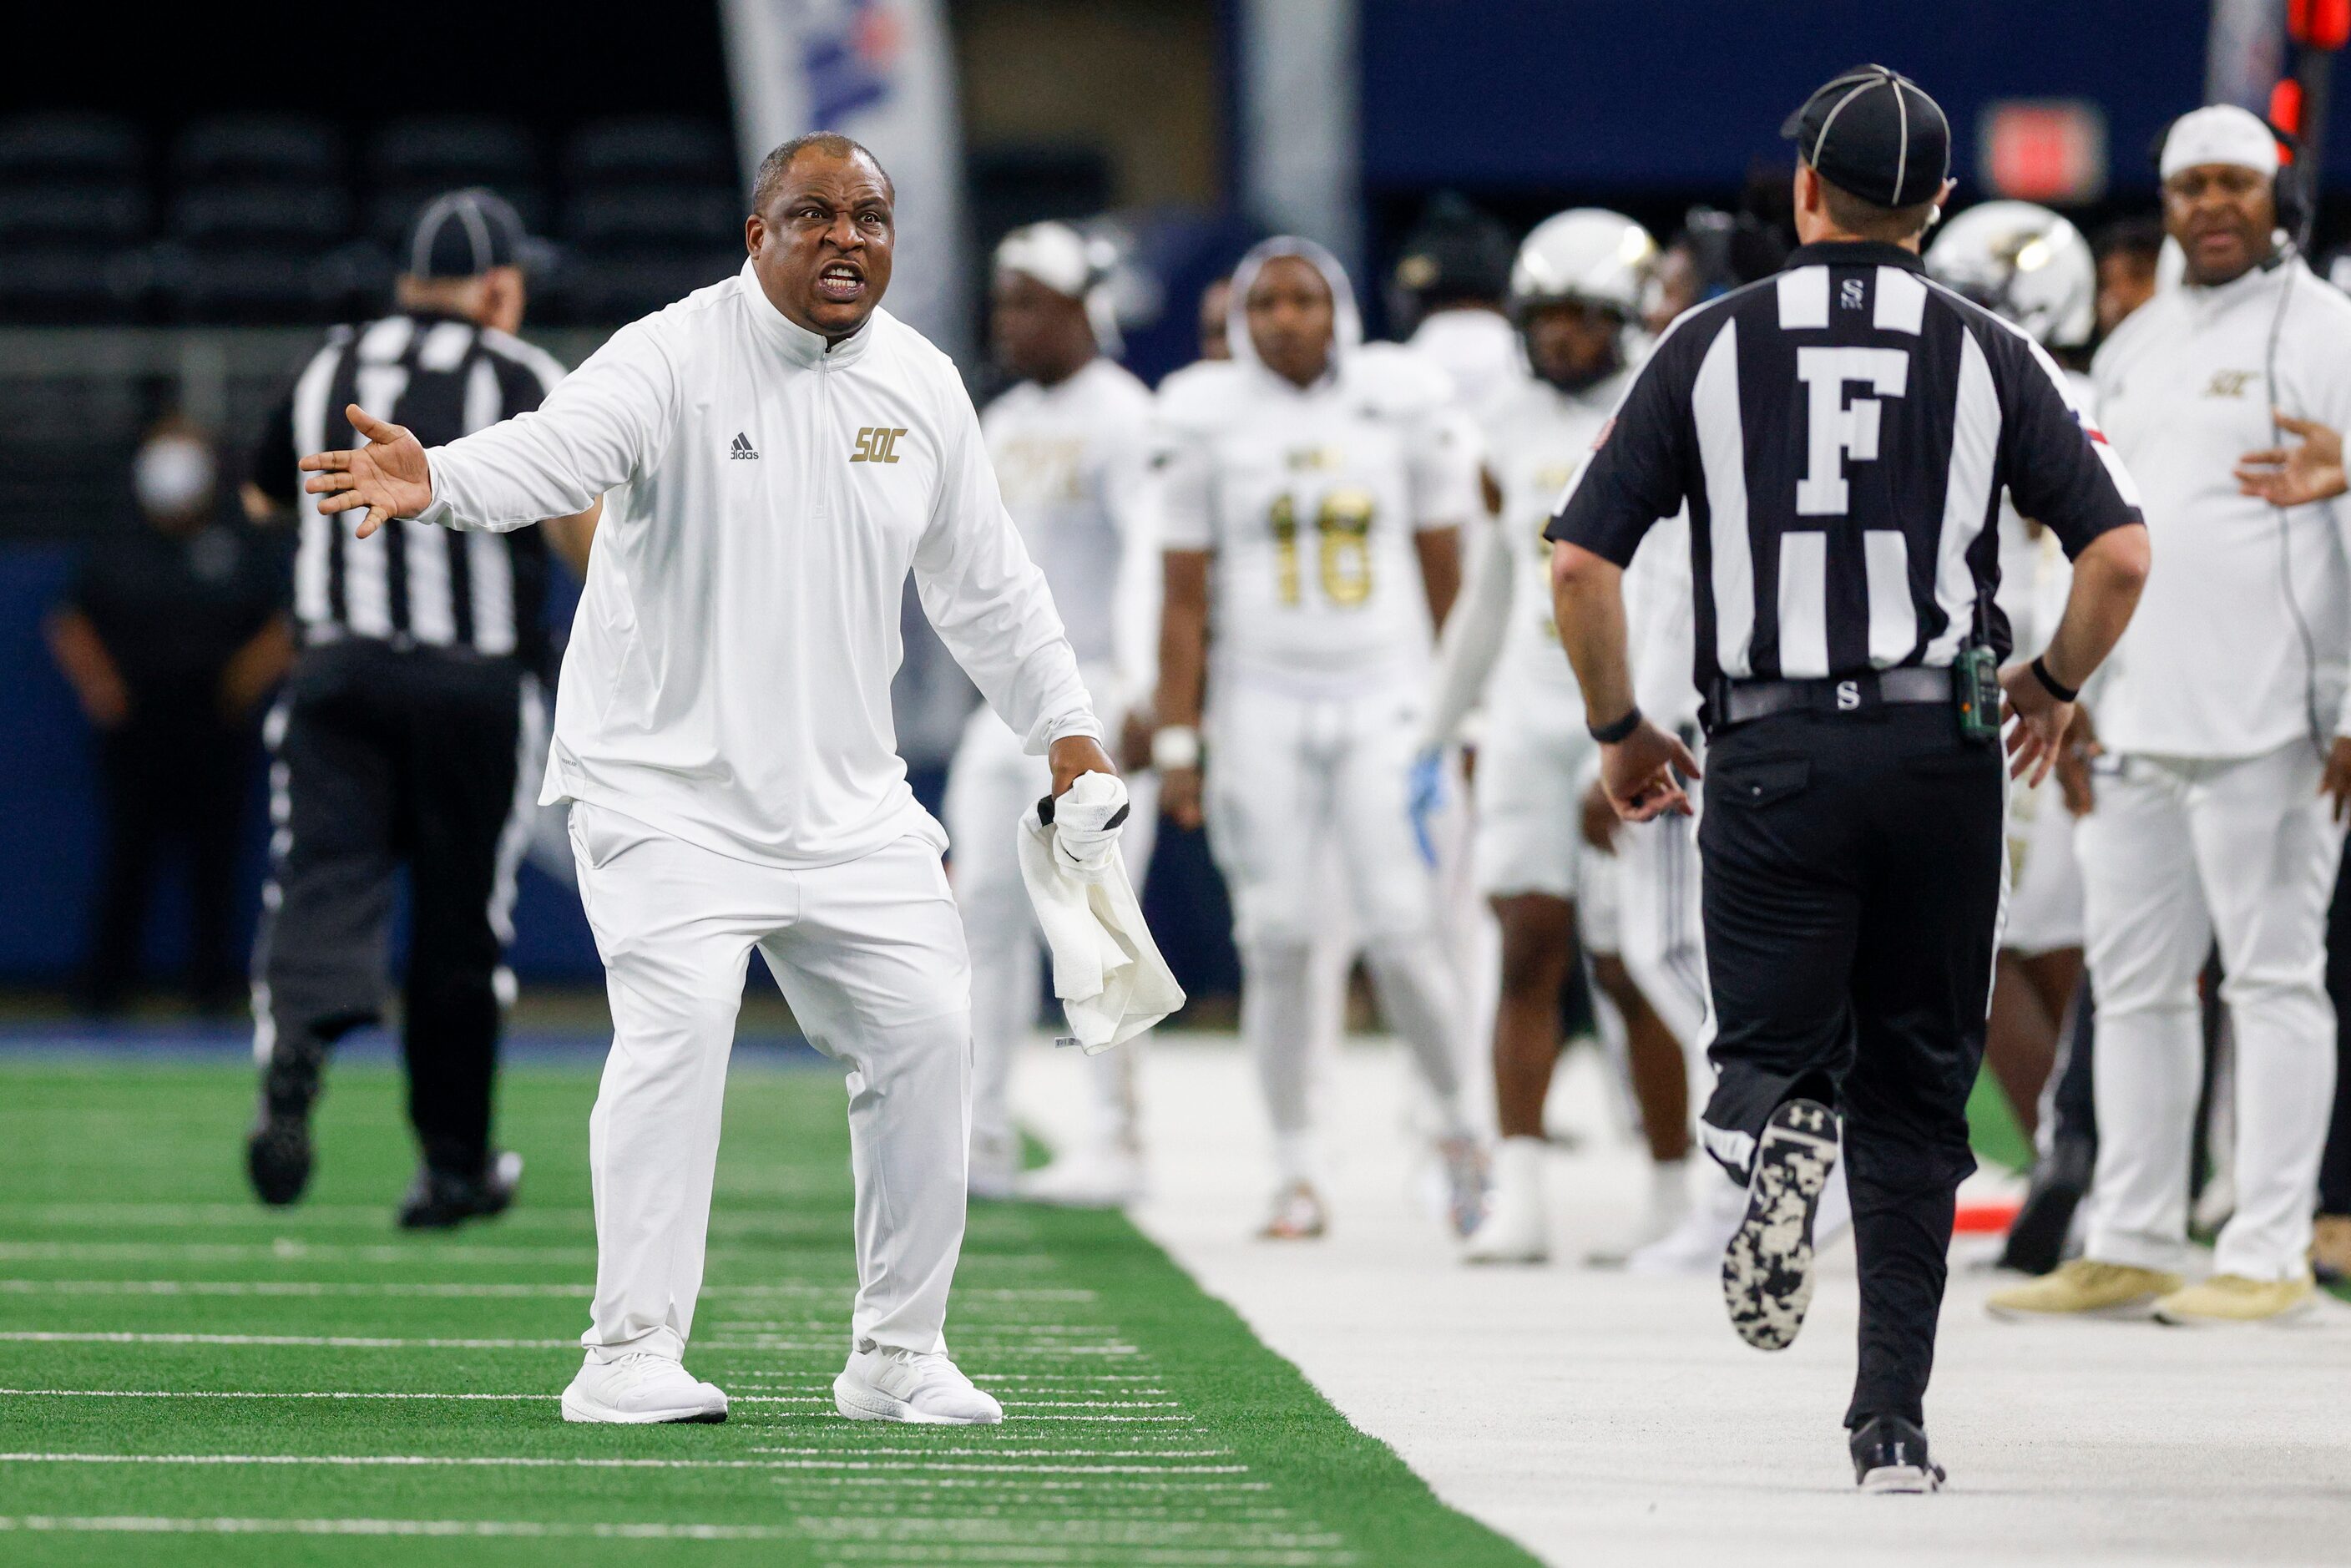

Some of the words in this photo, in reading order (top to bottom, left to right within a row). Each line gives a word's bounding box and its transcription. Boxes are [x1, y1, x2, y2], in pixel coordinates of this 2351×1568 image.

[849, 427, 908, 463] SOC
[1797, 346, 1909, 516] F
[730, 450, 760, 460] didas
[1836, 680, 1861, 711] S
